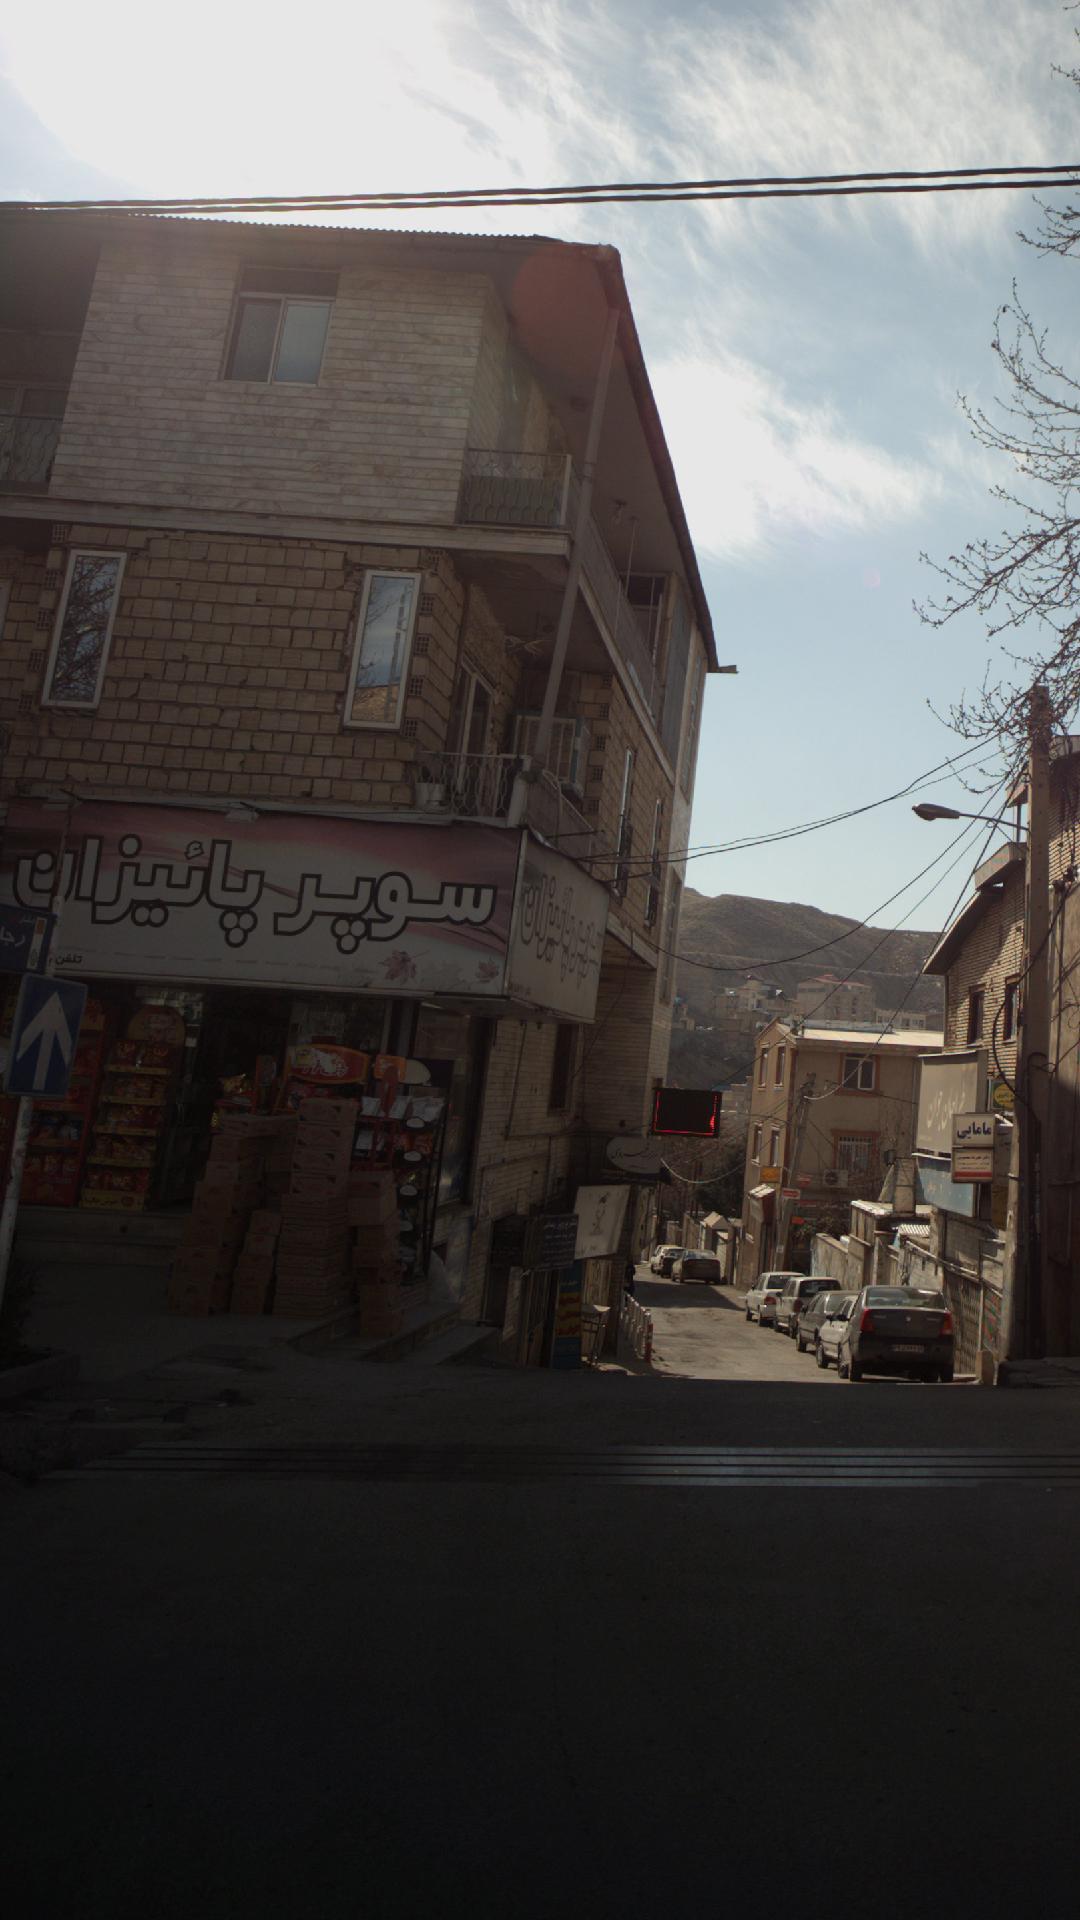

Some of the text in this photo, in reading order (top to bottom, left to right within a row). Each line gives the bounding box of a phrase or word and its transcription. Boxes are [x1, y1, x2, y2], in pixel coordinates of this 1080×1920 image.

[274, 871, 498, 955] سوپر
[0, 925, 27, 947] رجا
[55, 952, 84, 965] تلفن
[956, 1120, 992, 1140] مامایی
